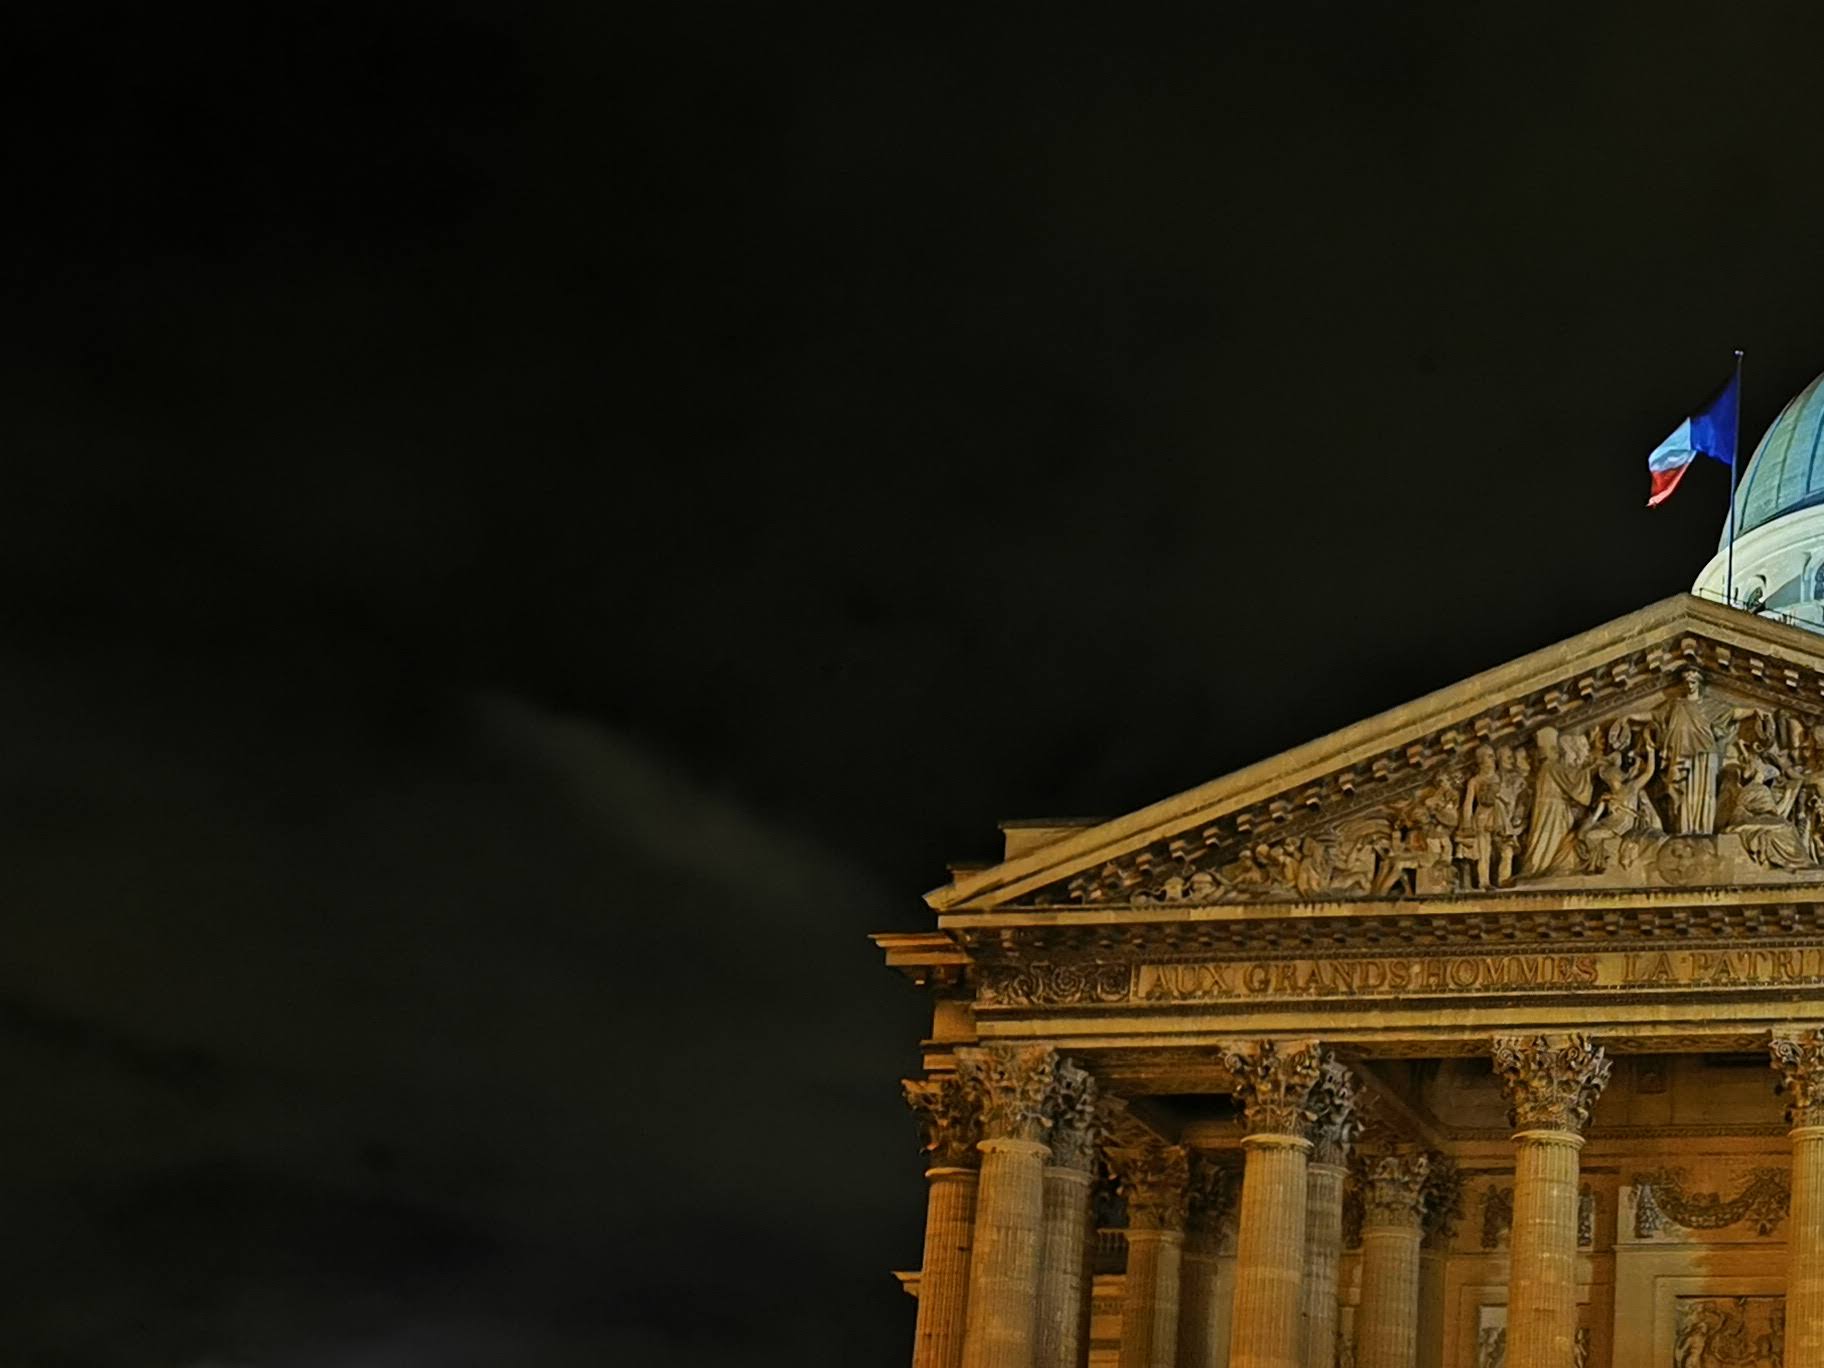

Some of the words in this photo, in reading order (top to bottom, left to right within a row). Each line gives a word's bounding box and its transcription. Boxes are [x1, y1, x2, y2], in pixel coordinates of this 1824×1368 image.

[1149, 964, 1228, 995] AUX
[1242, 960, 1410, 994] GRANDS
[1420, 955, 1599, 988] HOMMES
[1621, 952, 1680, 984] LA
